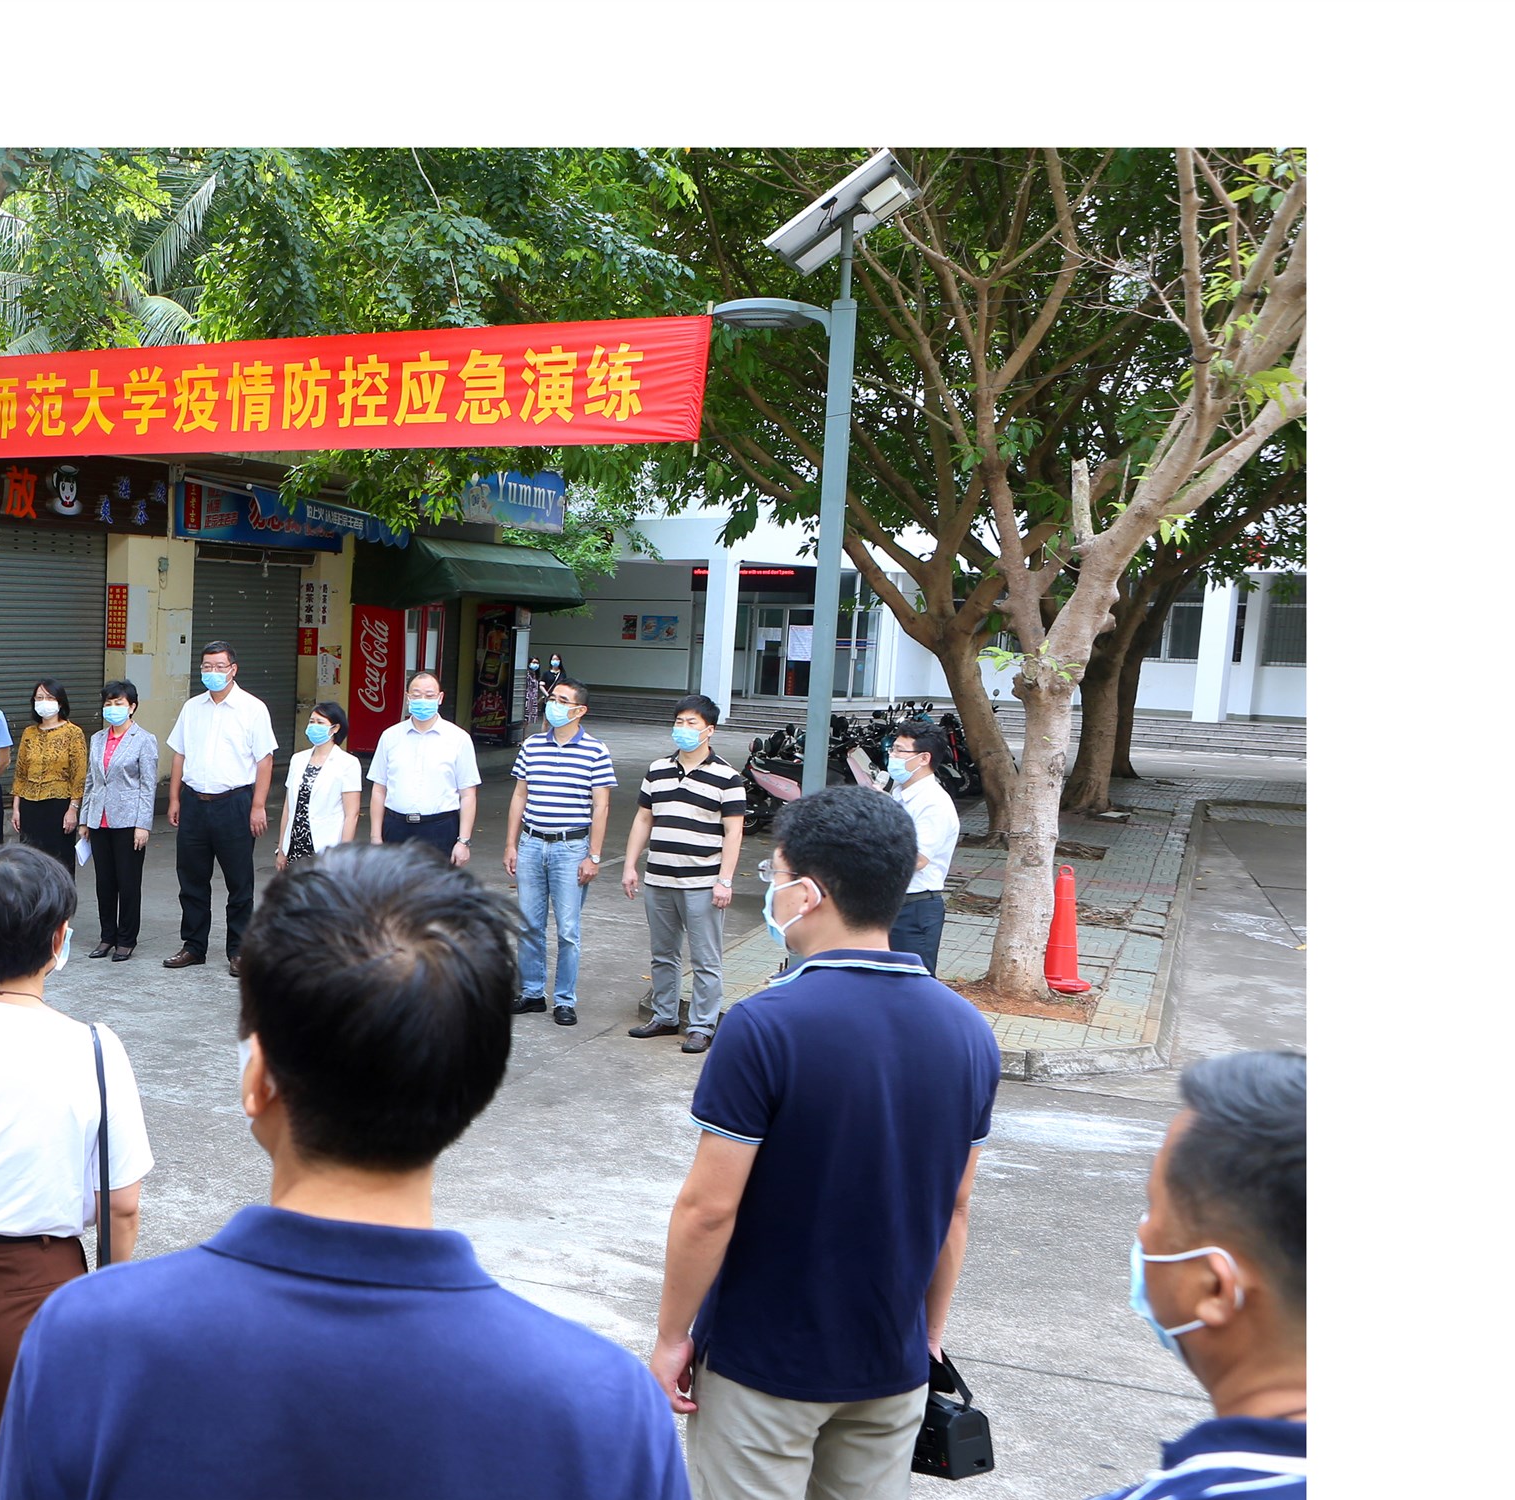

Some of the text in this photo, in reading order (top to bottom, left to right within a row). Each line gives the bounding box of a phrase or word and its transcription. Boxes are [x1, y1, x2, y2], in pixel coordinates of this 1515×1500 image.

[498, 471, 556, 517] Yummy
[304, 583, 314, 624] 奶茶水果
